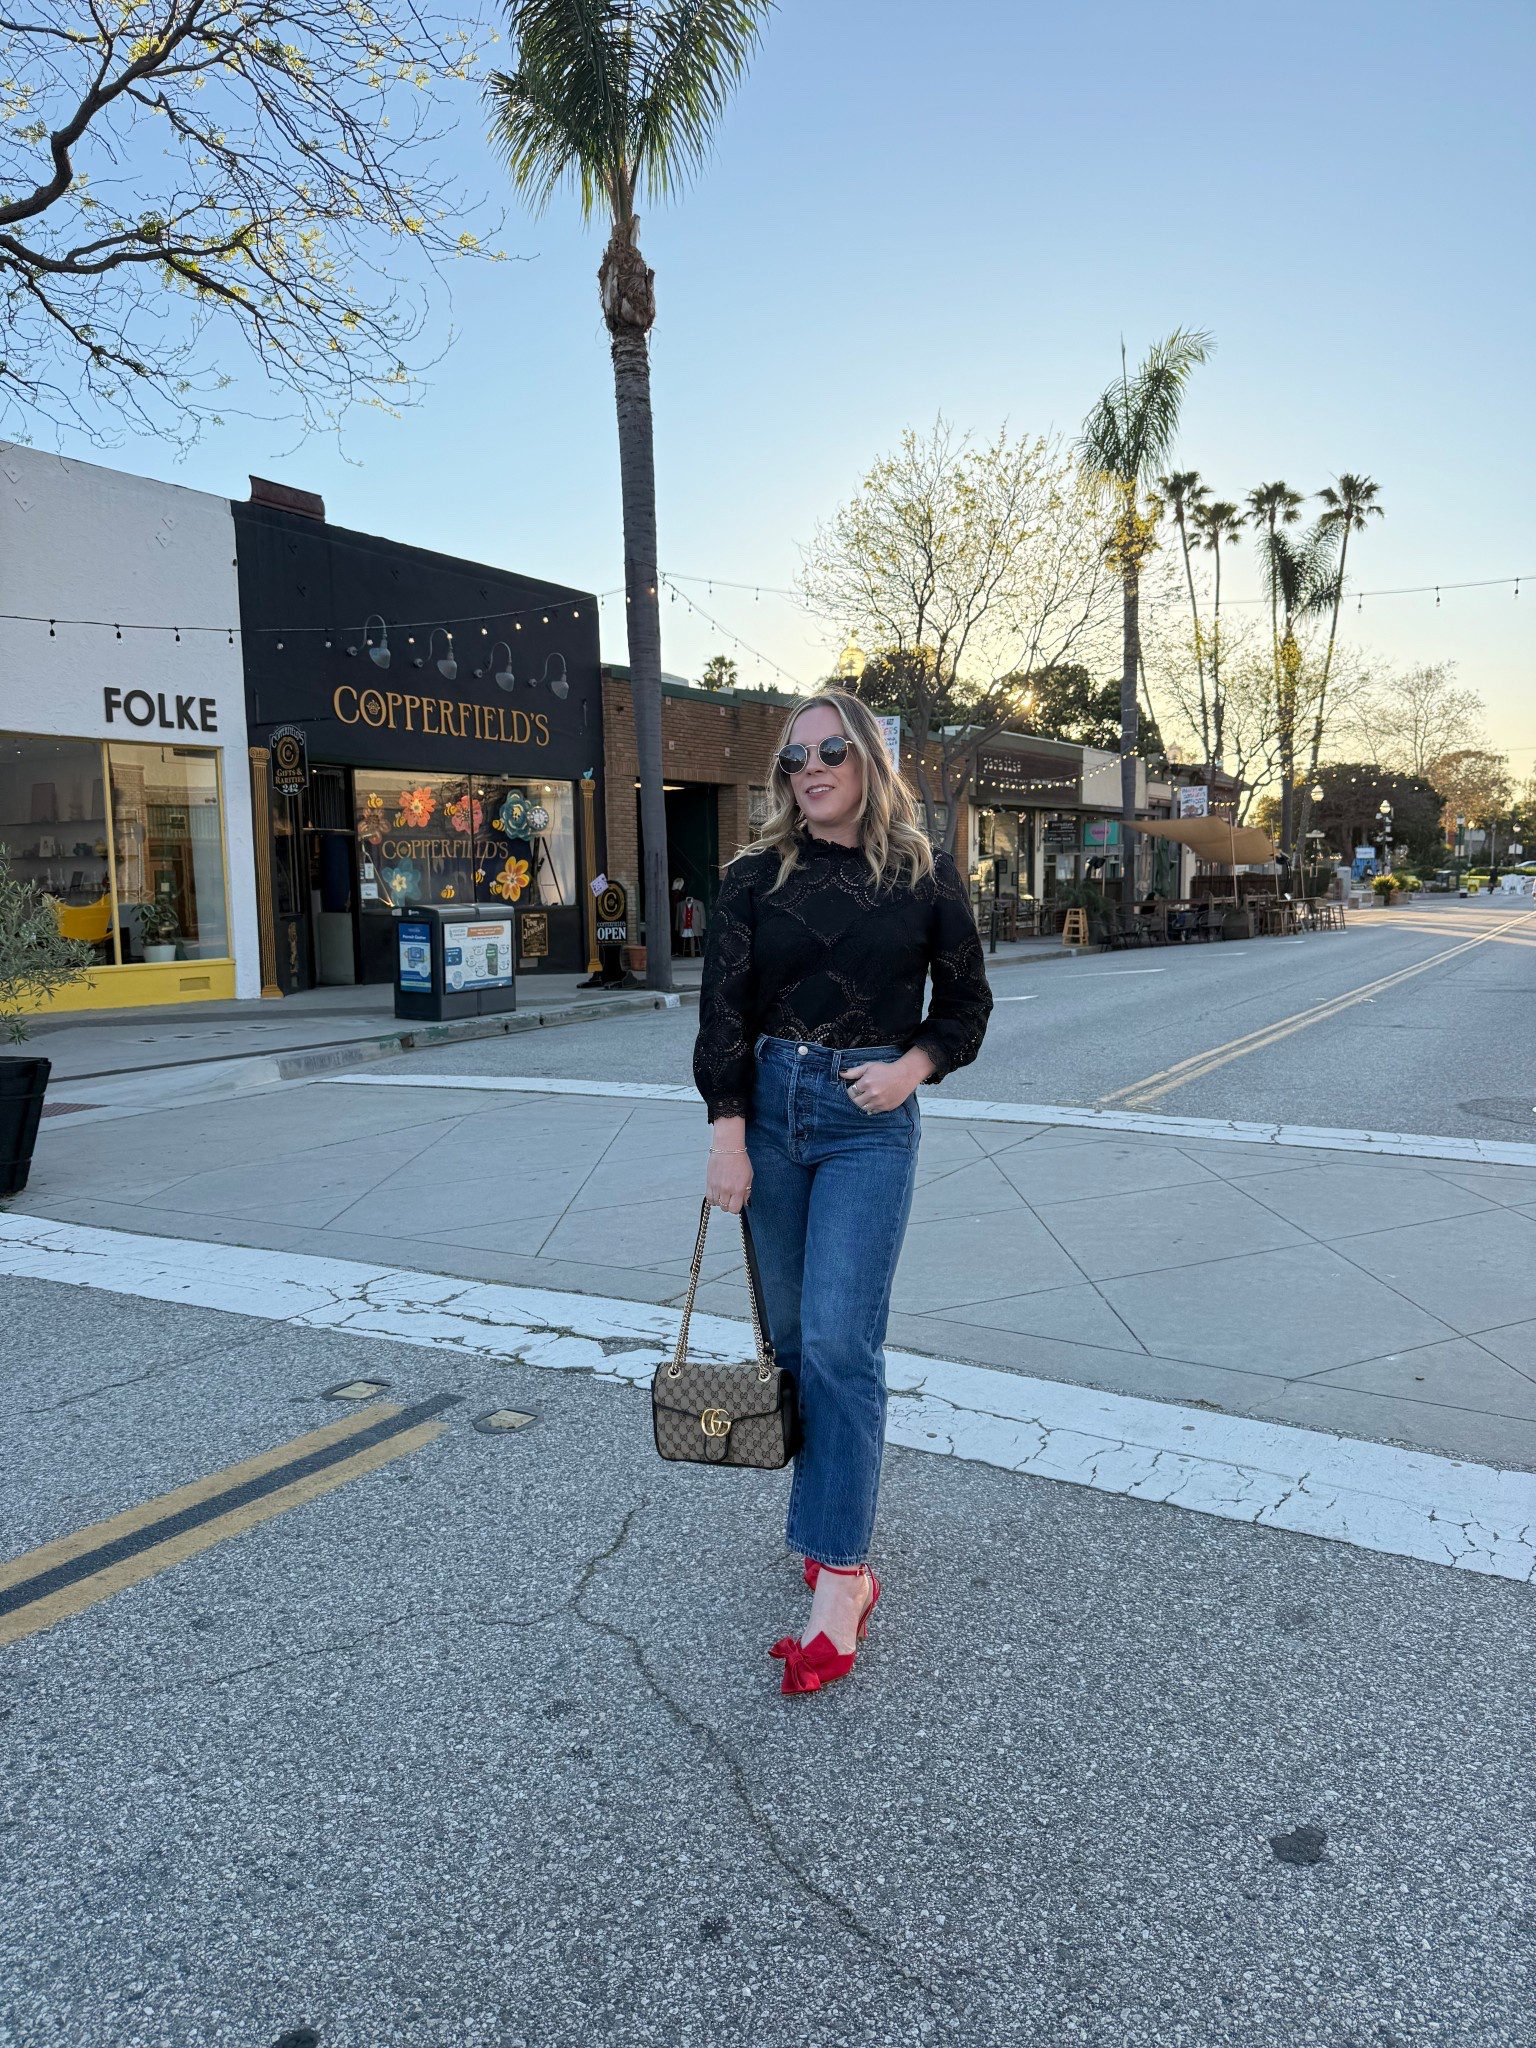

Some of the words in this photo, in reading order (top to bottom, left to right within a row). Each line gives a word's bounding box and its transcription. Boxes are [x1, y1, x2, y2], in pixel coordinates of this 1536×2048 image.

[104, 687, 218, 732] FOLKE
[333, 685, 550, 746] COPPERFIELD'S
[276, 769, 296, 777] GIFTS
[296, 768, 303, 776] &
[275, 776, 305, 785] RARITIES
[282, 783, 299, 793] 242
[597, 927, 626, 940] OPEN
